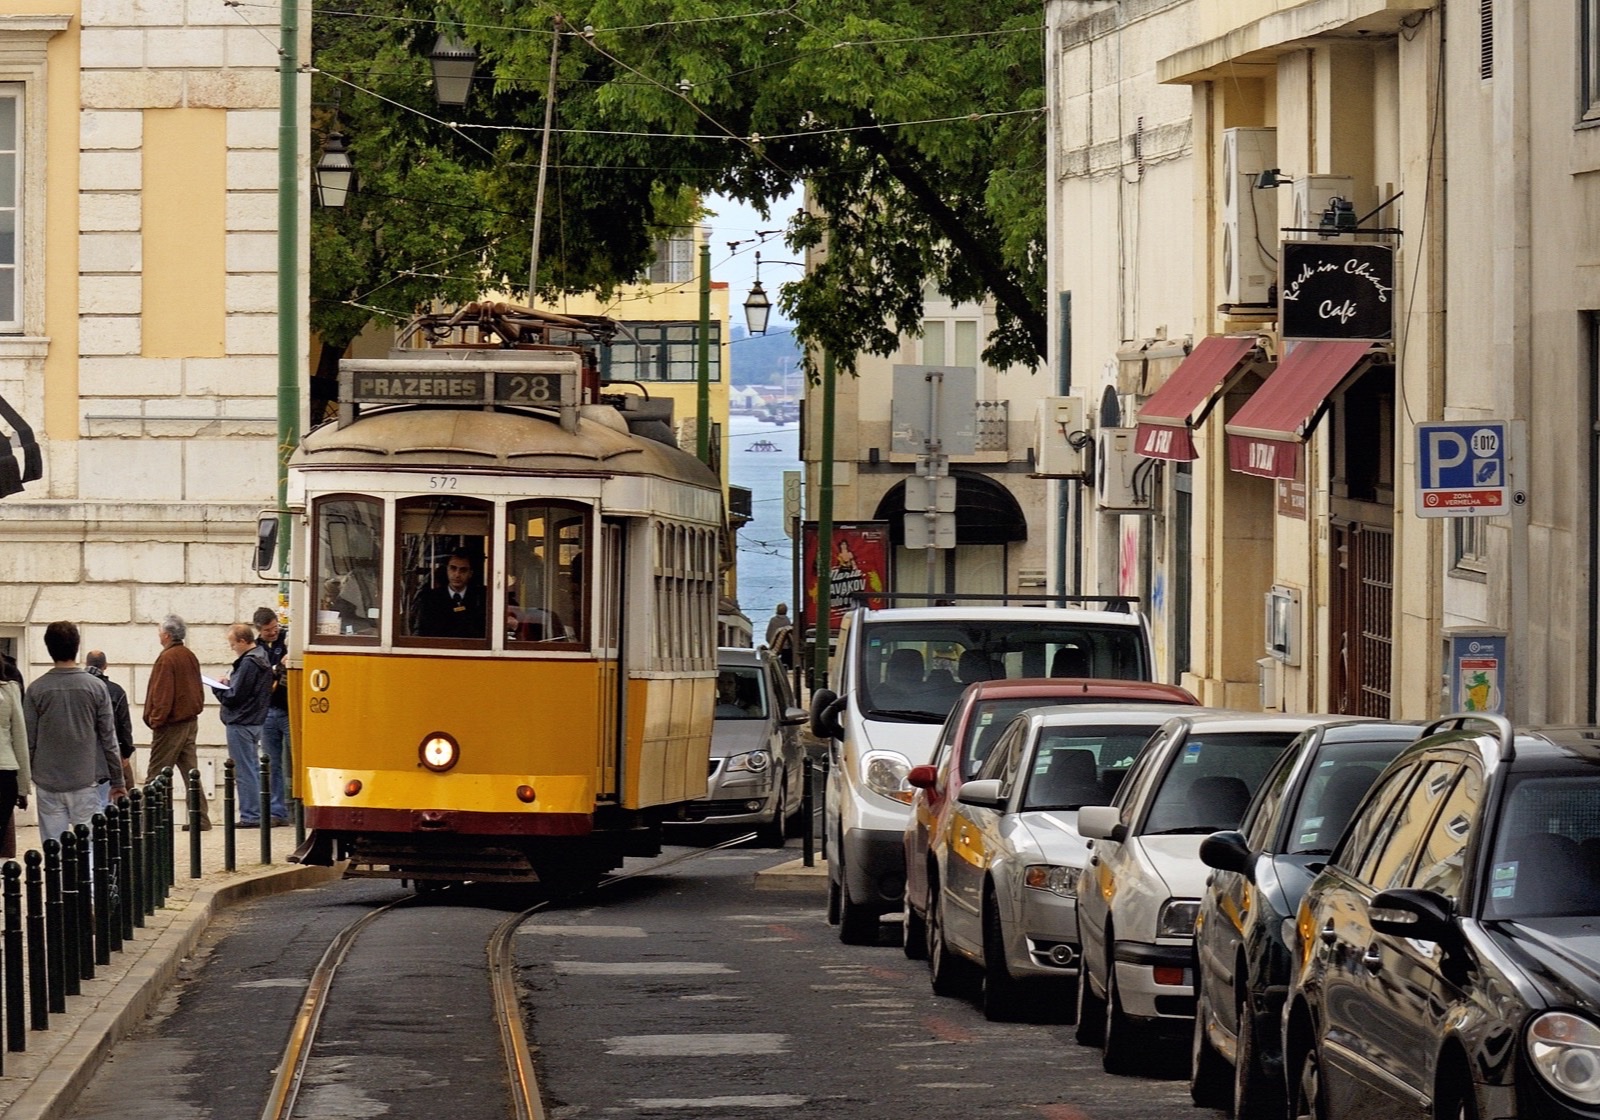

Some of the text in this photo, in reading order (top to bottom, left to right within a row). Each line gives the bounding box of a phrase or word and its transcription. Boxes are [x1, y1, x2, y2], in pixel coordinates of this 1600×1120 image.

[1283, 259, 1392, 302] Rock in Chiado
[1319, 300, 1357, 324] Café
[360, 378, 476, 396] PRAZERES
[510, 376, 549, 401] 28
[1480, 435, 1496, 450] 012
[1429, 431, 1468, 488] P
[429, 476, 457, 489] 572
